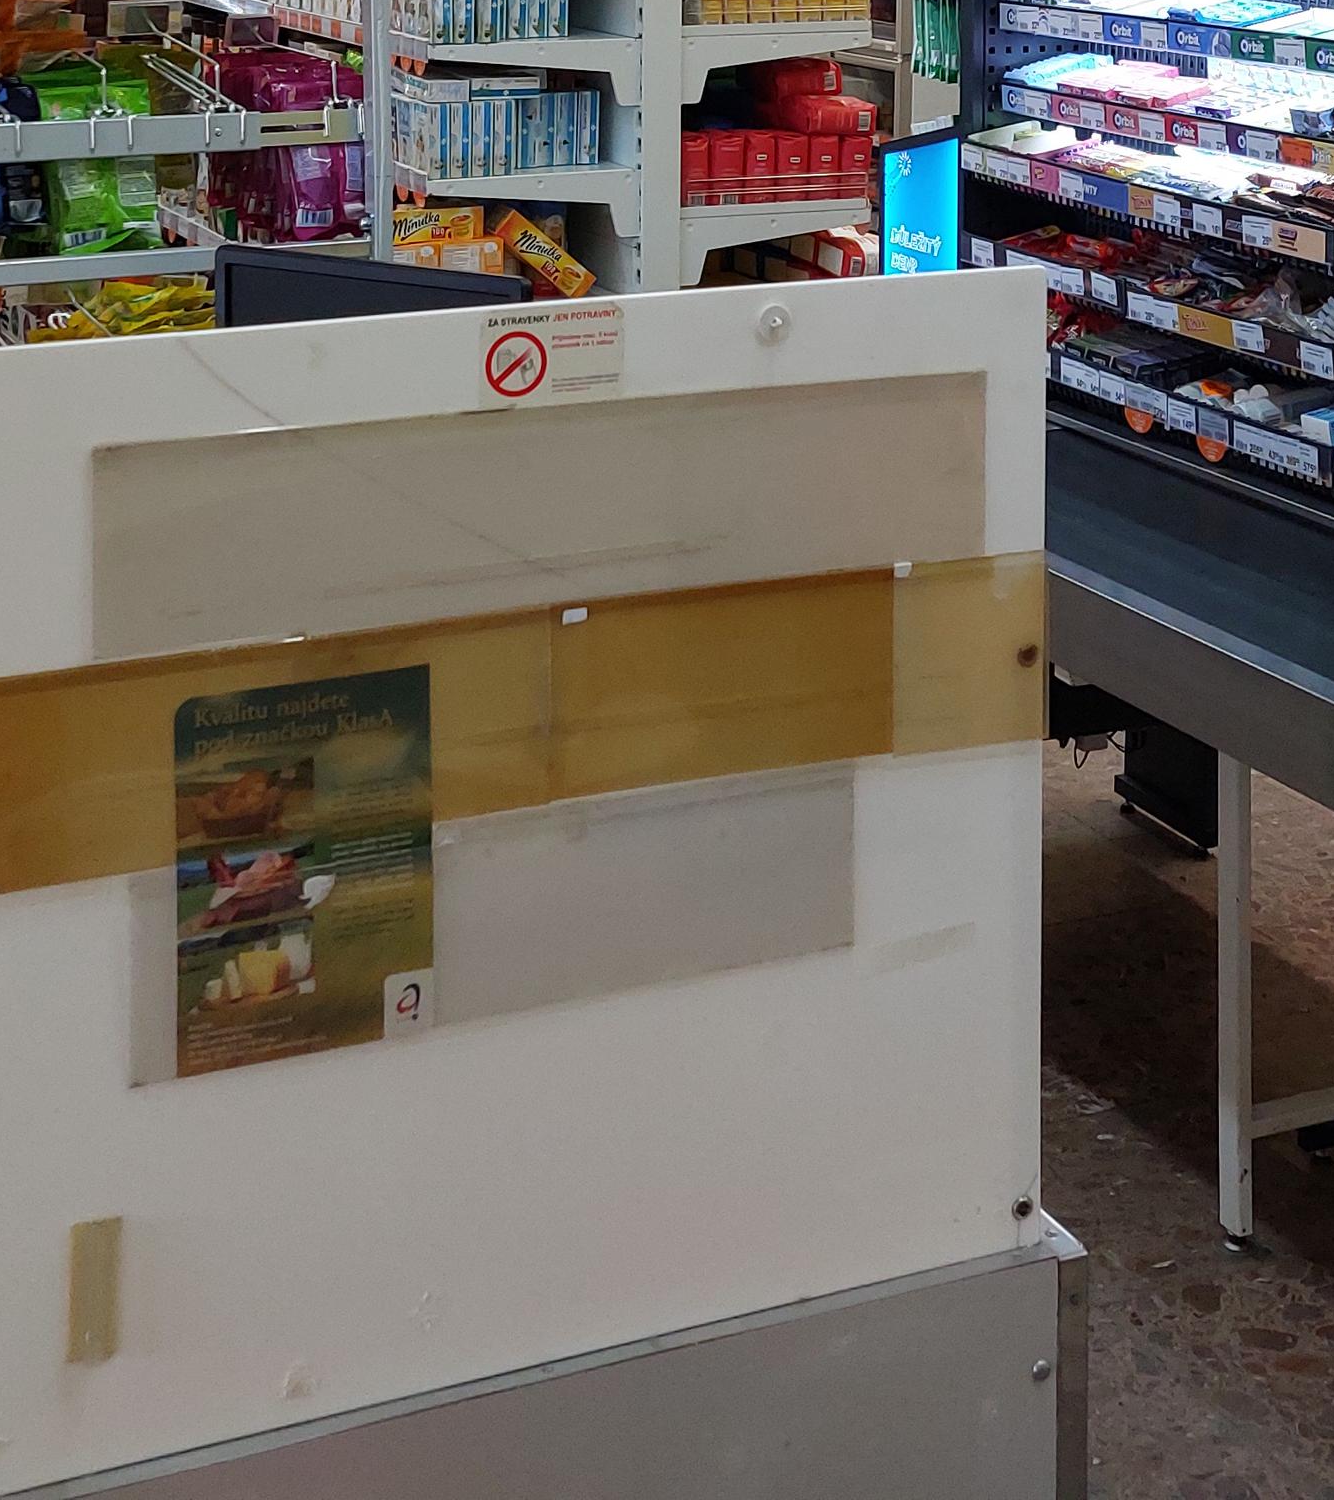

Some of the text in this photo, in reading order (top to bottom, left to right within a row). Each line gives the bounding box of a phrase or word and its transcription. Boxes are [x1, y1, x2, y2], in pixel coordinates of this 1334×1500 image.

[1111, 19, 1133, 40] Orbit
[1176, 26, 1201, 48] Orbit
[1239, 34, 1266, 54] Orbit
[1058, 99, 1082, 119] Orbit
[1113, 111, 1135, 130] Orbit
[1171, 120, 1196, 141] Orbit
[501, 314, 551, 327] STRAVENKY
[193, 702, 269, 729] Kvalitu
